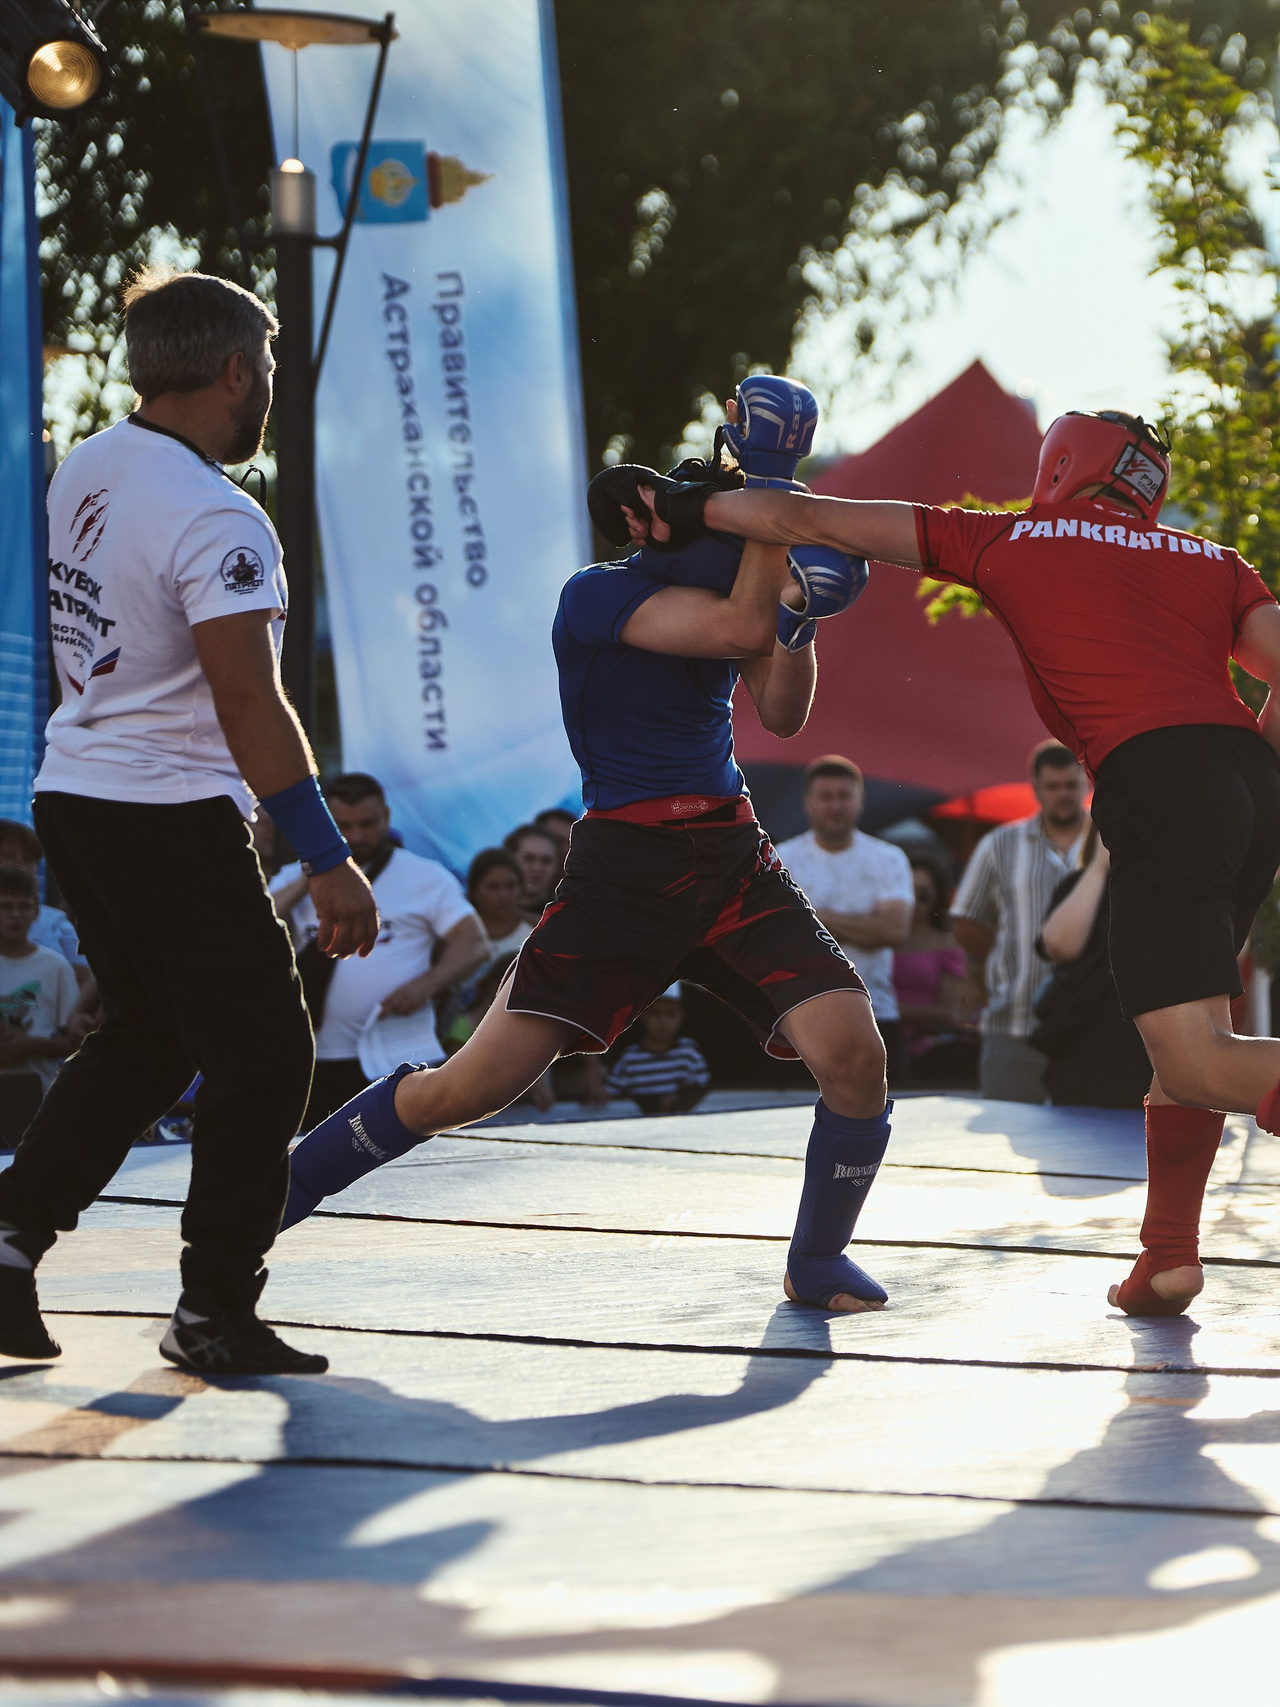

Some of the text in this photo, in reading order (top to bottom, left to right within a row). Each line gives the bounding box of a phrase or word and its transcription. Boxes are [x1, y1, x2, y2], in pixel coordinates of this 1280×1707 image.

[381, 271, 449, 752] Астраханской области
[435, 270, 488, 589] Правительство
[1009, 518, 1225, 561] PANKRATION
